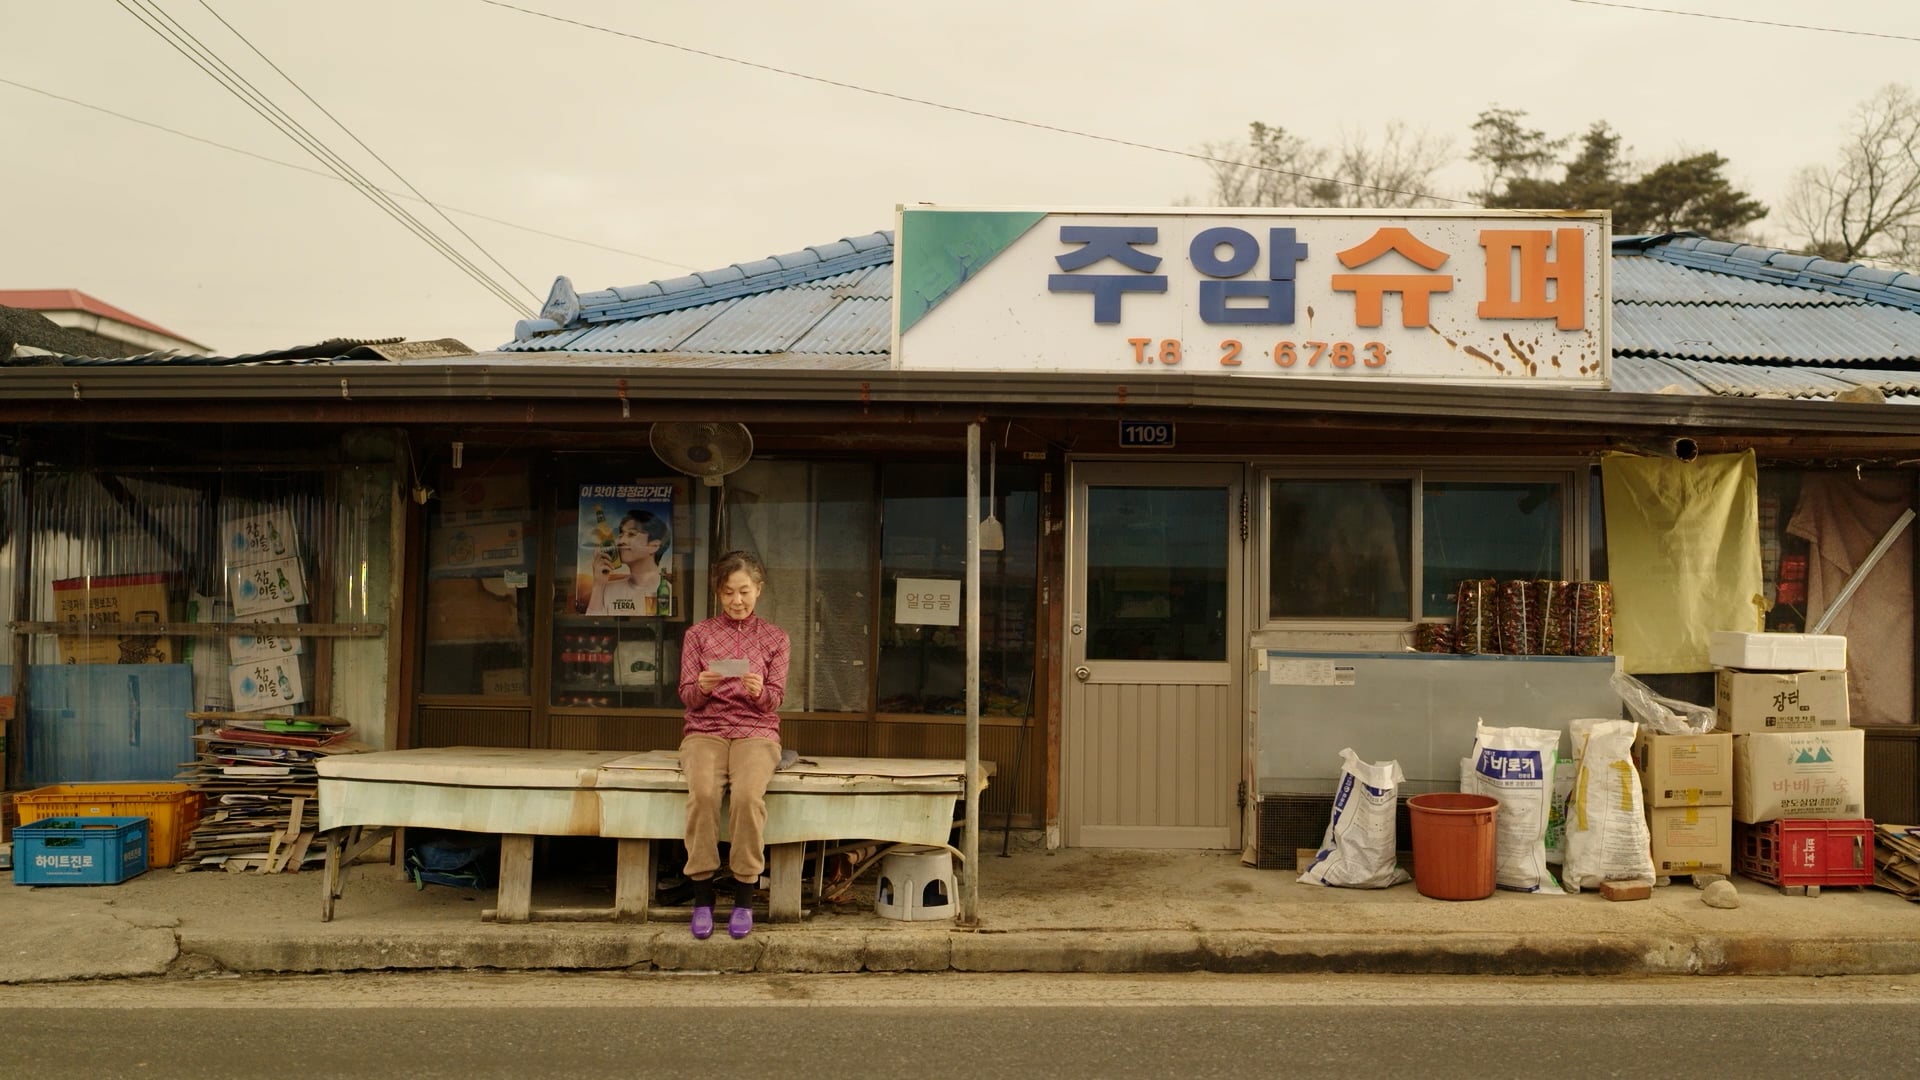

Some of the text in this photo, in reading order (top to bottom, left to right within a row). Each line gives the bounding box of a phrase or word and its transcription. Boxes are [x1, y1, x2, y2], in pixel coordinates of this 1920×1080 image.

[1048, 225, 1586, 331] 주암슈퍼
[1274, 341, 1389, 369] 6783
[1126, 426, 1168, 442] 1109
[581, 486, 592, 497] 이
[594, 486, 616, 498] 맛이
[254, 567, 269, 585] 참
[259, 582, 279, 601] 이슬
[612, 601, 636, 610] TERRA
[905, 592, 952, 611] 얼음물
[254, 667, 269, 683] 참
[259, 679, 279, 698] 이슬
[1772, 689, 1800, 712] 장터
[1772, 777, 1829, 796] 바베큐
[35, 855, 94, 869] 하이트진로
